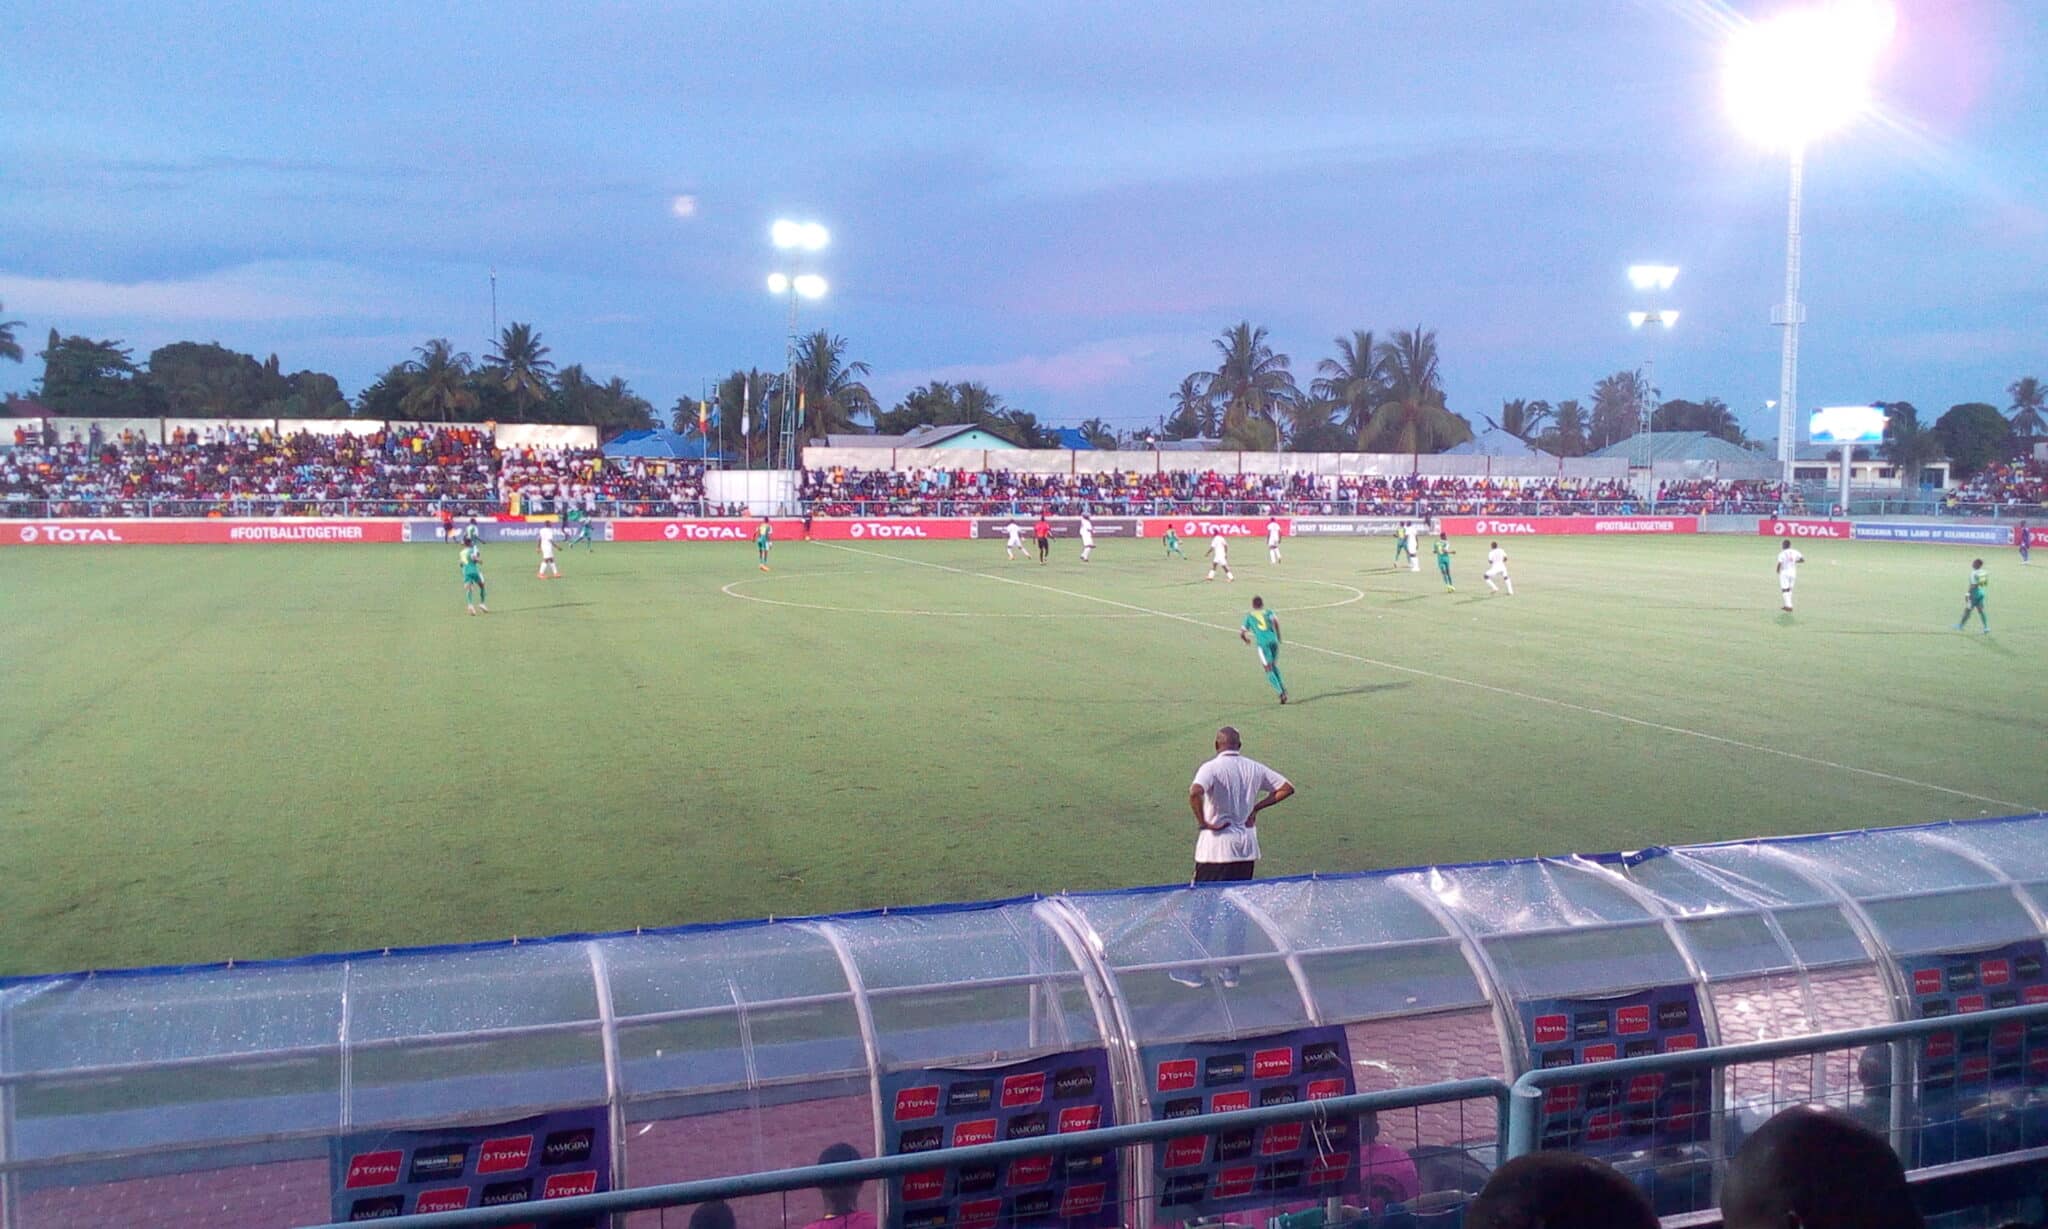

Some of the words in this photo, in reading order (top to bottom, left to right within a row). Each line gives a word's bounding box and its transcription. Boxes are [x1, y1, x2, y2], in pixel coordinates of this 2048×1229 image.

[682, 524, 747, 538] TOTAL
[866, 523, 927, 537] TOTAL
[1198, 522, 1251, 535] TOTAL
[1489, 520, 1536, 533] TOTAL
[1595, 521, 1674, 531] #FOOTBALLTOGETHER
[1787, 522, 1839, 536] TOTAL
[42, 526, 122, 541] TOTAL
[230, 526, 362, 539] #FOOTBALLTOGETHER
[1895, 529, 1908, 537] THE
[1910, 530, 1931, 538] LAND
[1543, 1025, 1566, 1033] TOTAL
[1167, 1072, 1193, 1080] TOTAL
[1013, 1086, 1041, 1095] TOTAL
[907, 1099, 936, 1108] TOTAL
[1221, 1103, 1248, 1112] TOTAL
[964, 1133, 993, 1142] TOTAL
[493, 1150, 527, 1160] TOTAL
[361, 1165, 398, 1175] TOTAL
[559, 1185, 590, 1196] TOTAL
[427, 1201, 464, 1212] TOTAL
